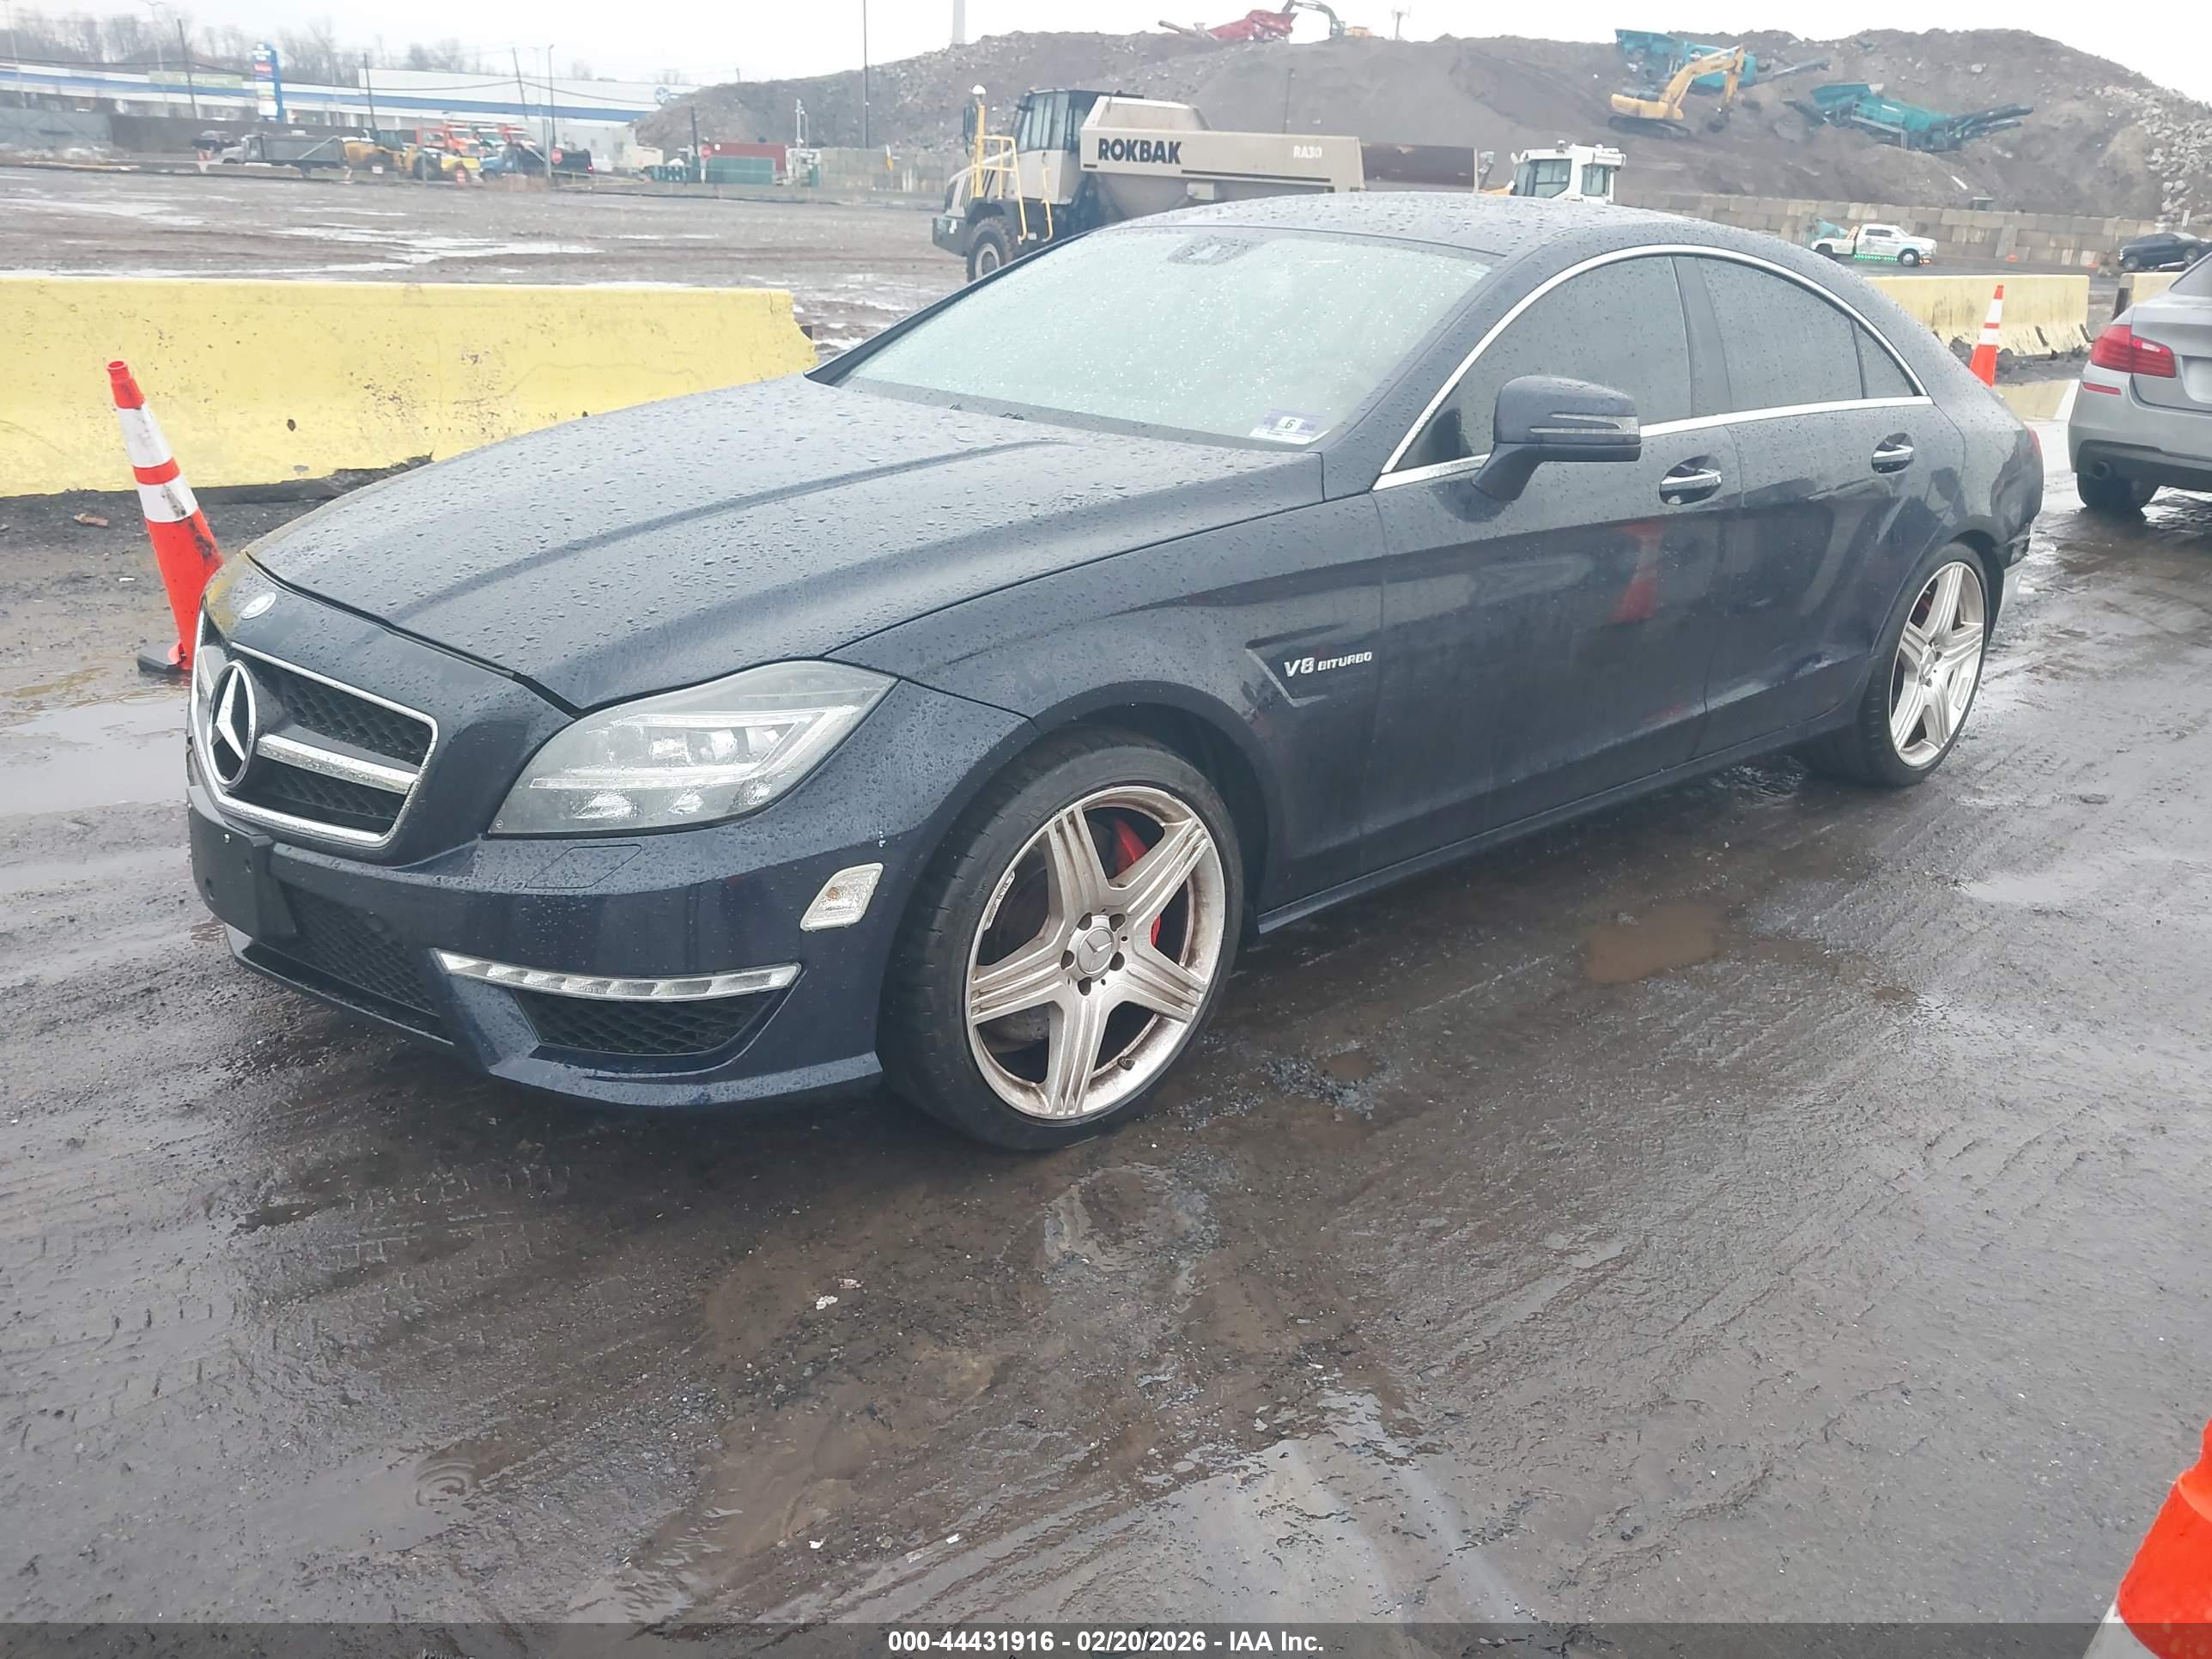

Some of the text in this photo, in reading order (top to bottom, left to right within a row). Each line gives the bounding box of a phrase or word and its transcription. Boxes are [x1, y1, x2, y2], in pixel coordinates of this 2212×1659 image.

[1097, 138, 1182, 165] ROKBAK
[1292, 145, 1322, 160] RA30
[1284, 418, 1297, 429] 6
[1284, 651, 1374, 678] V8 BITURBO
